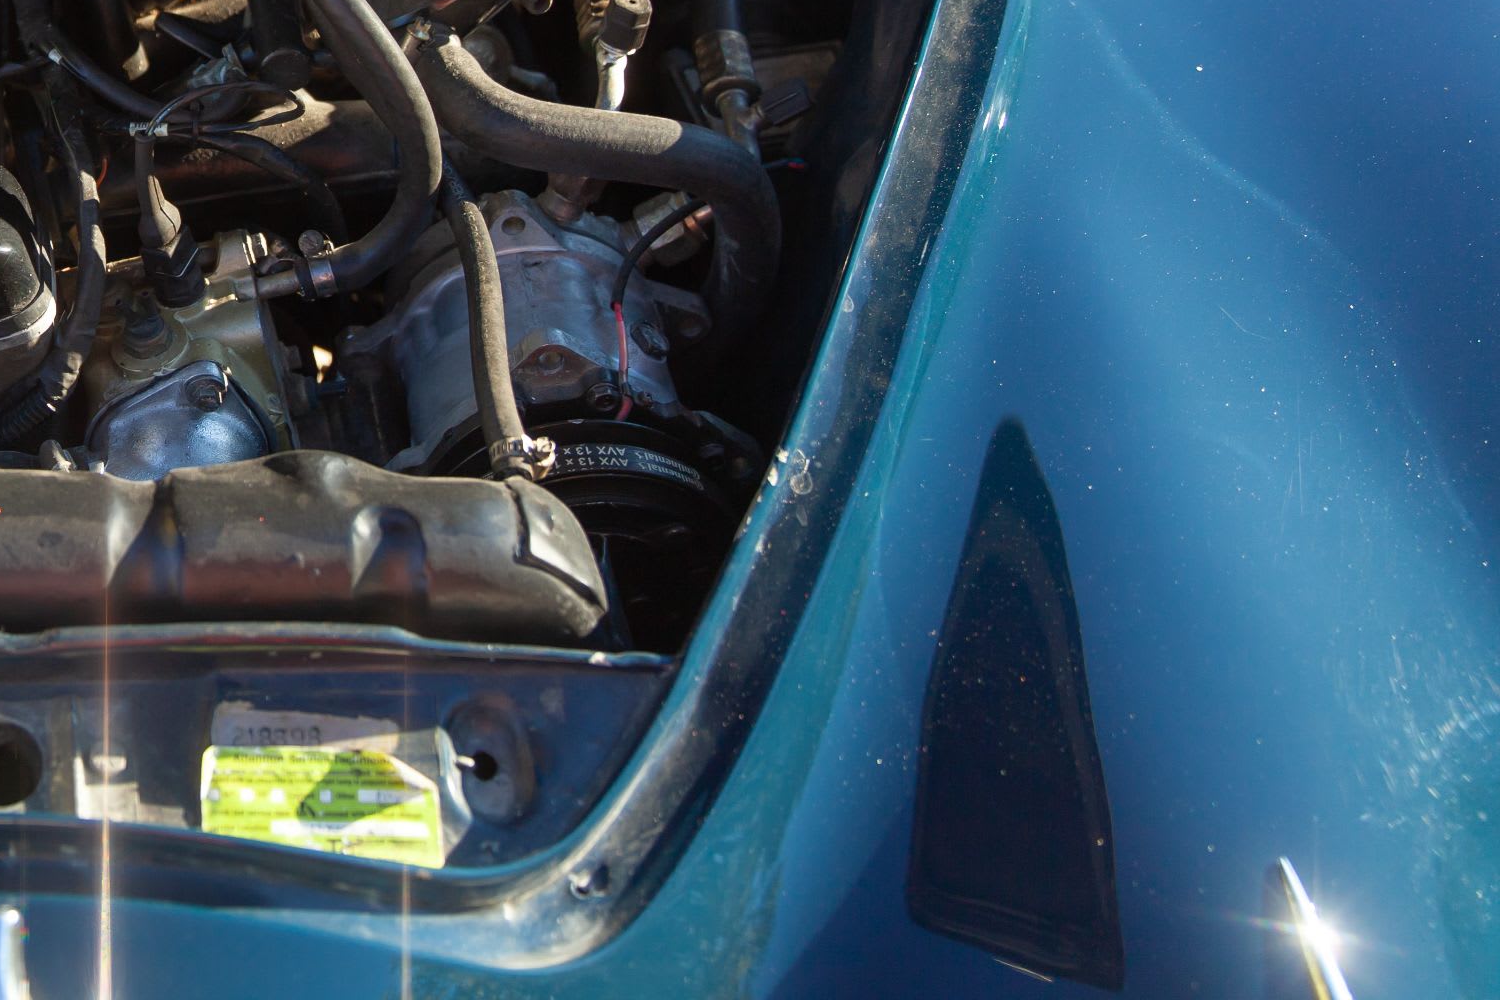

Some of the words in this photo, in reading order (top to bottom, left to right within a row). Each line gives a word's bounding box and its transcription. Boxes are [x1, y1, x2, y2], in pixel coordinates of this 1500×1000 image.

[576, 446, 592, 456] 13
[596, 446, 627, 456] AVX
[578, 457, 595, 467] 13
[600, 457, 629, 468] AVX
